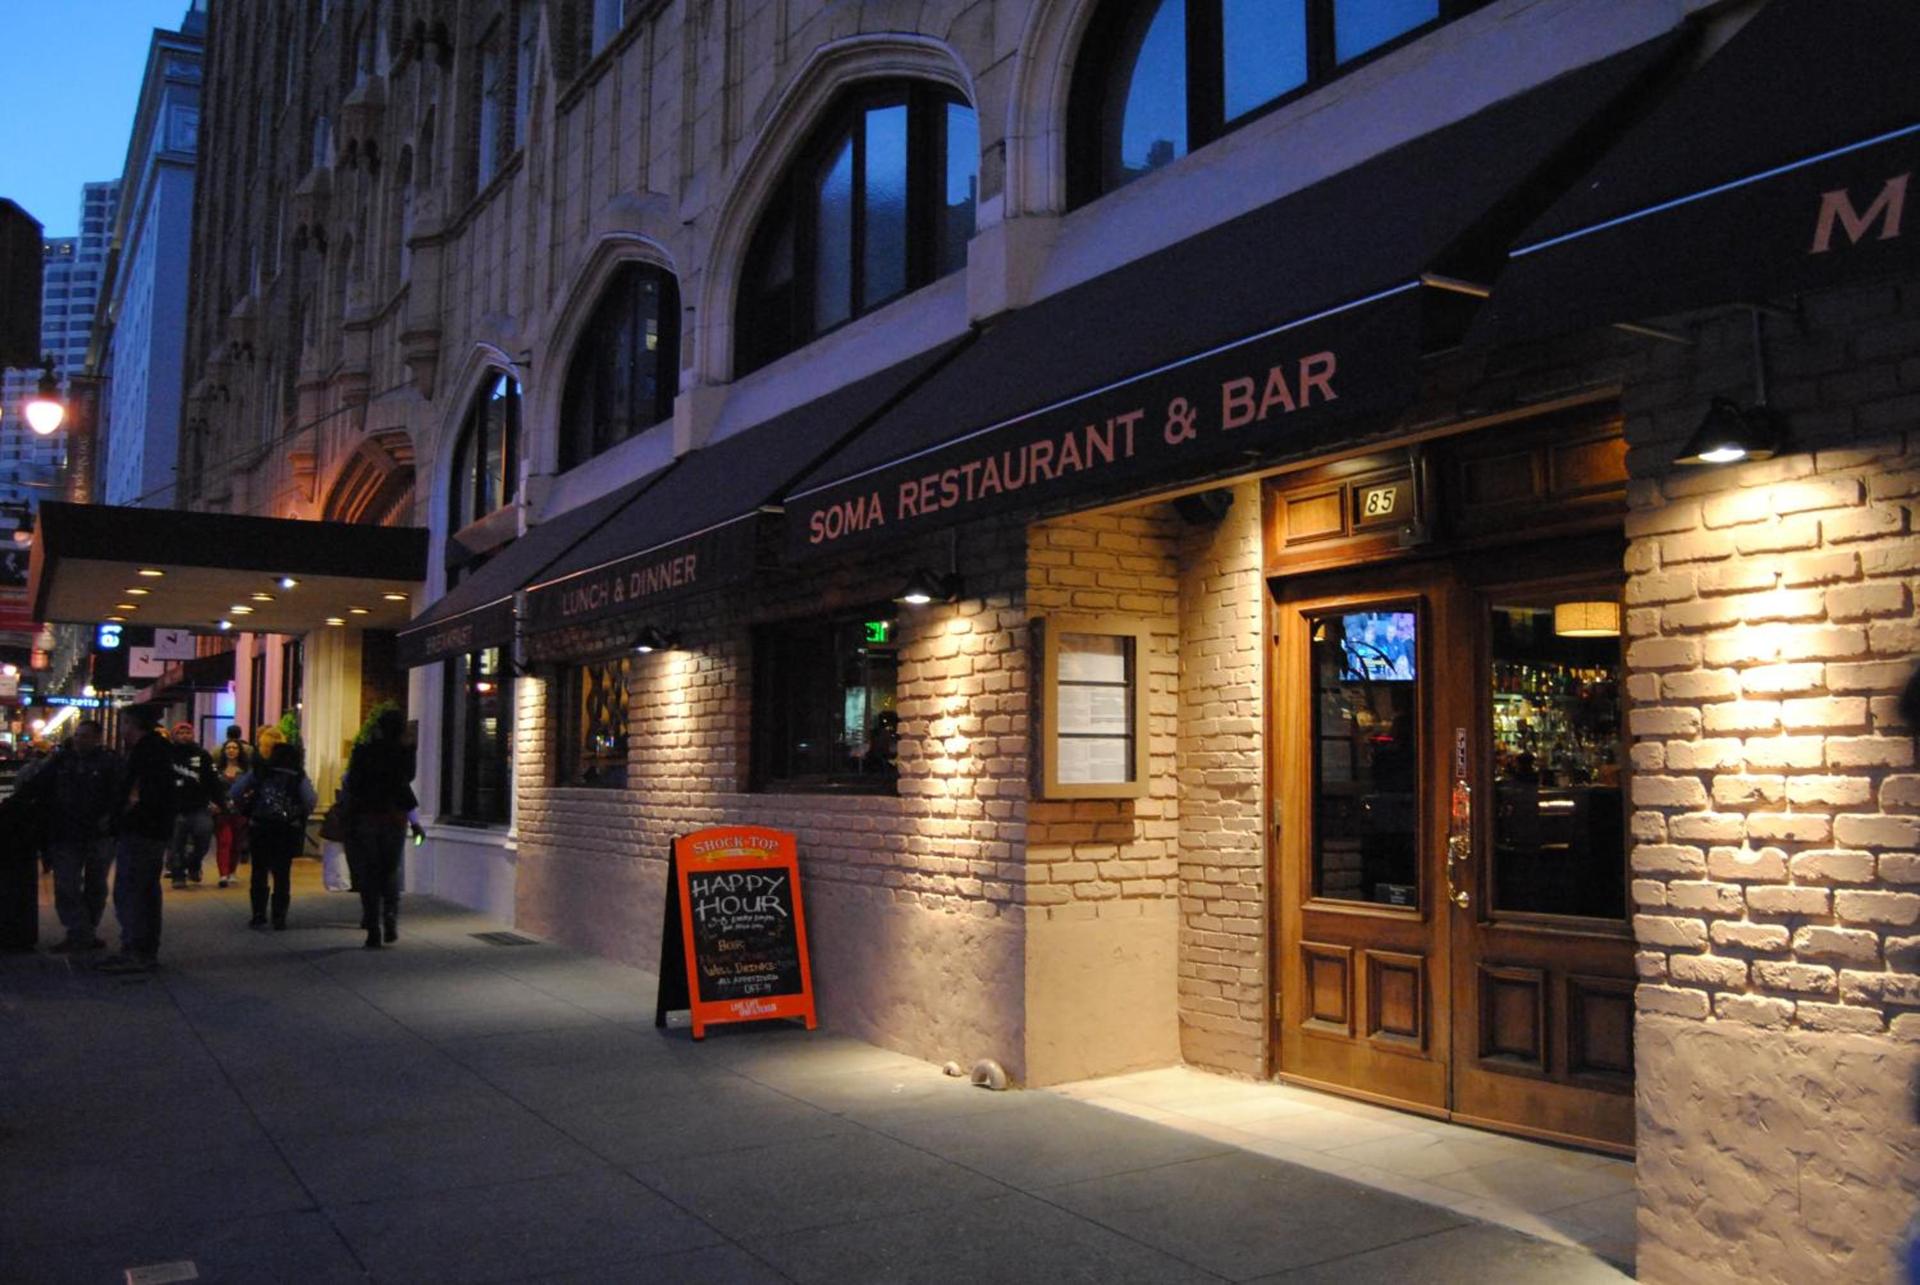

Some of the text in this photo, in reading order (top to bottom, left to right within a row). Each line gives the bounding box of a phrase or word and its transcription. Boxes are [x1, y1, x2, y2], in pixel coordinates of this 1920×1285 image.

[809, 350, 1339, 545] SOMA RESTAURANT & BAR
[1367, 489, 1394, 514] 85
[562, 553, 697, 616] LUNCH & DINNER
[692, 837, 744, 854] SHOCK
[750, 836, 779, 850] TOP
[692, 873, 785, 898] HAPPY
[695, 894, 787, 921] HOUR
